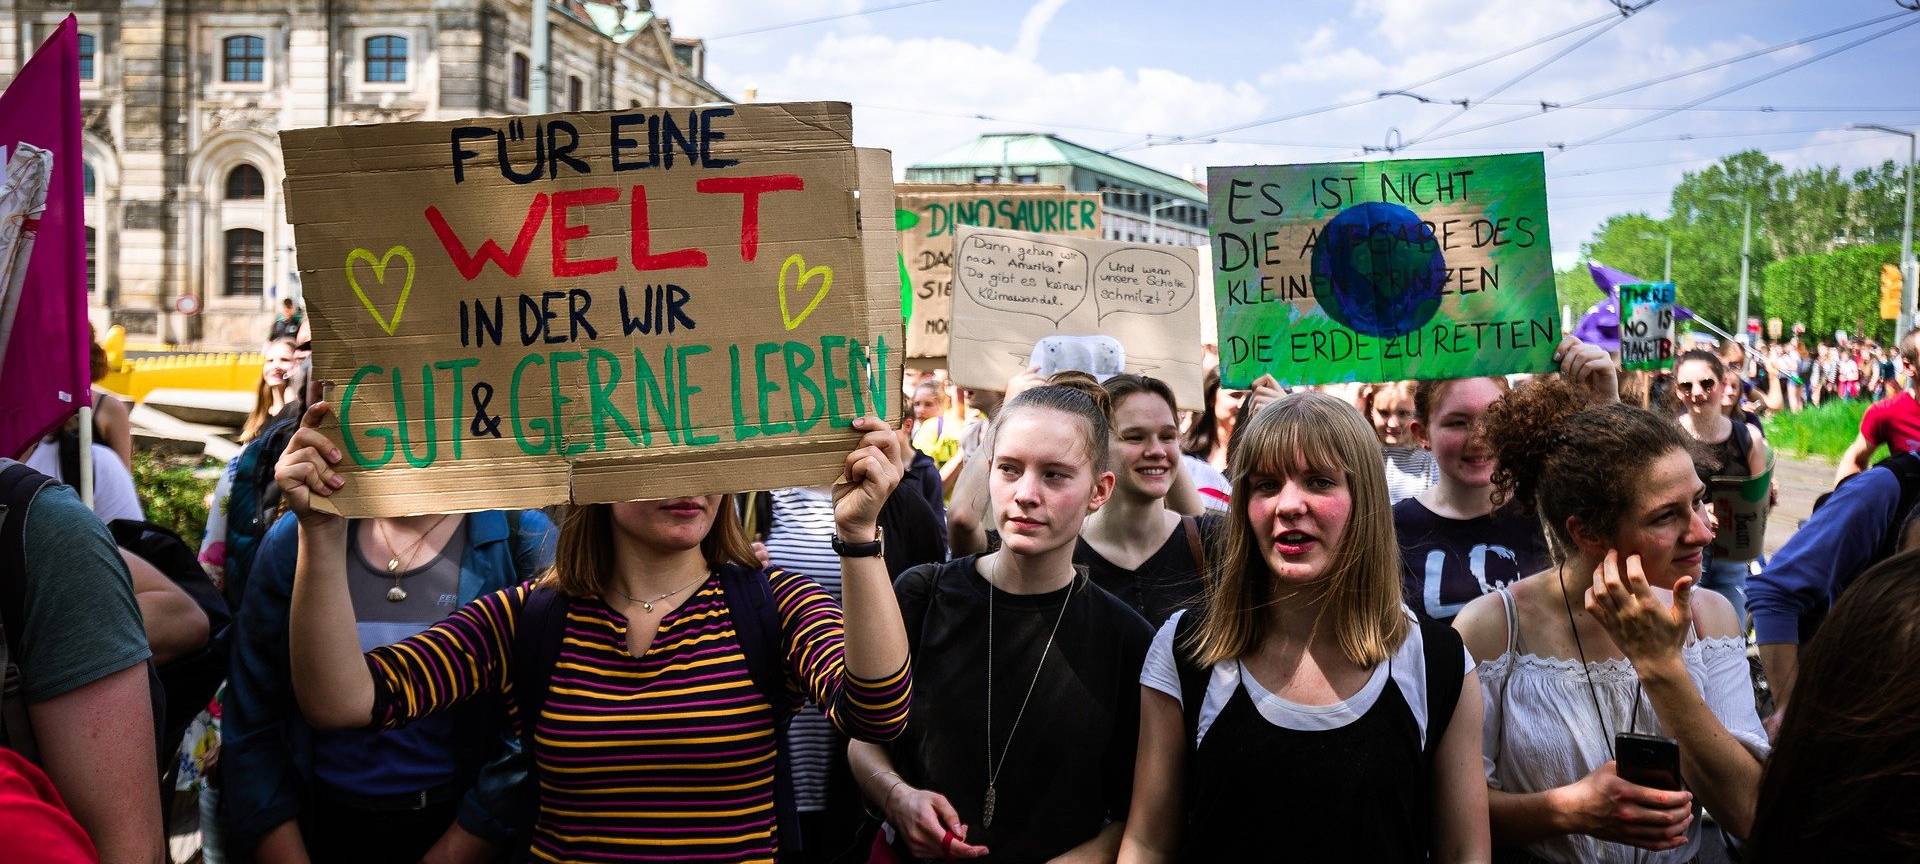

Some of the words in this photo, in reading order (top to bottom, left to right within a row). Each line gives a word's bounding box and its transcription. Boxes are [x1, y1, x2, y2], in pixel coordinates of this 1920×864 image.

[452, 118, 590, 184] FÜR
[611, 108, 740, 172] EINE
[1228, 178, 1284, 224] ES
[1312, 177, 1358, 209] IST
[1381, 170, 1474, 204] NICHT
[424, 174, 805, 281] WELT
[924, 199, 1097, 237] DINOSAURIER
[974, 238, 1010, 253] Dann
[1017, 245, 1053, 260] gehen
[1060, 252, 1077, 260] wir
[1218, 231, 1281, 272] DIE
[1470, 217, 1535, 248] DES
[966, 255, 995, 265] nach
[1008, 259, 1063, 274] Amerika!
[1108, 262, 1134, 273] Und
[1142, 267, 1170, 276] wenn
[964, 267, 983, 279] Da
[989, 273, 1015, 287] gibt
[1021, 278, 1037, 287] es
[1046, 278, 1082, 291] keinen
[1100, 274, 1140, 286] unsere
[1146, 276, 1187, 289] Scholle
[978, 287, 1063, 306] Klimawandel.
[1100, 288, 1161, 305] schmilzt
[1622, 285, 1669, 303] THERE
[459, 296, 503, 348] IN
[519, 289, 597, 345] DER
[619, 284, 696, 335] WIR
[1658, 310, 1673, 330] IS
[1624, 320, 1648, 337] NO
[1227, 335, 1273, 365] DIE
[1291, 331, 1372, 363] ERDE
[1384, 328, 1422, 360] ZU
[1432, 317, 1554, 354] RETTEN
[341, 358, 479, 470] GUT
[471, 382, 502, 438] &
[511, 344, 720, 455] GERNE
[729, 335, 888, 442] LEBEN
